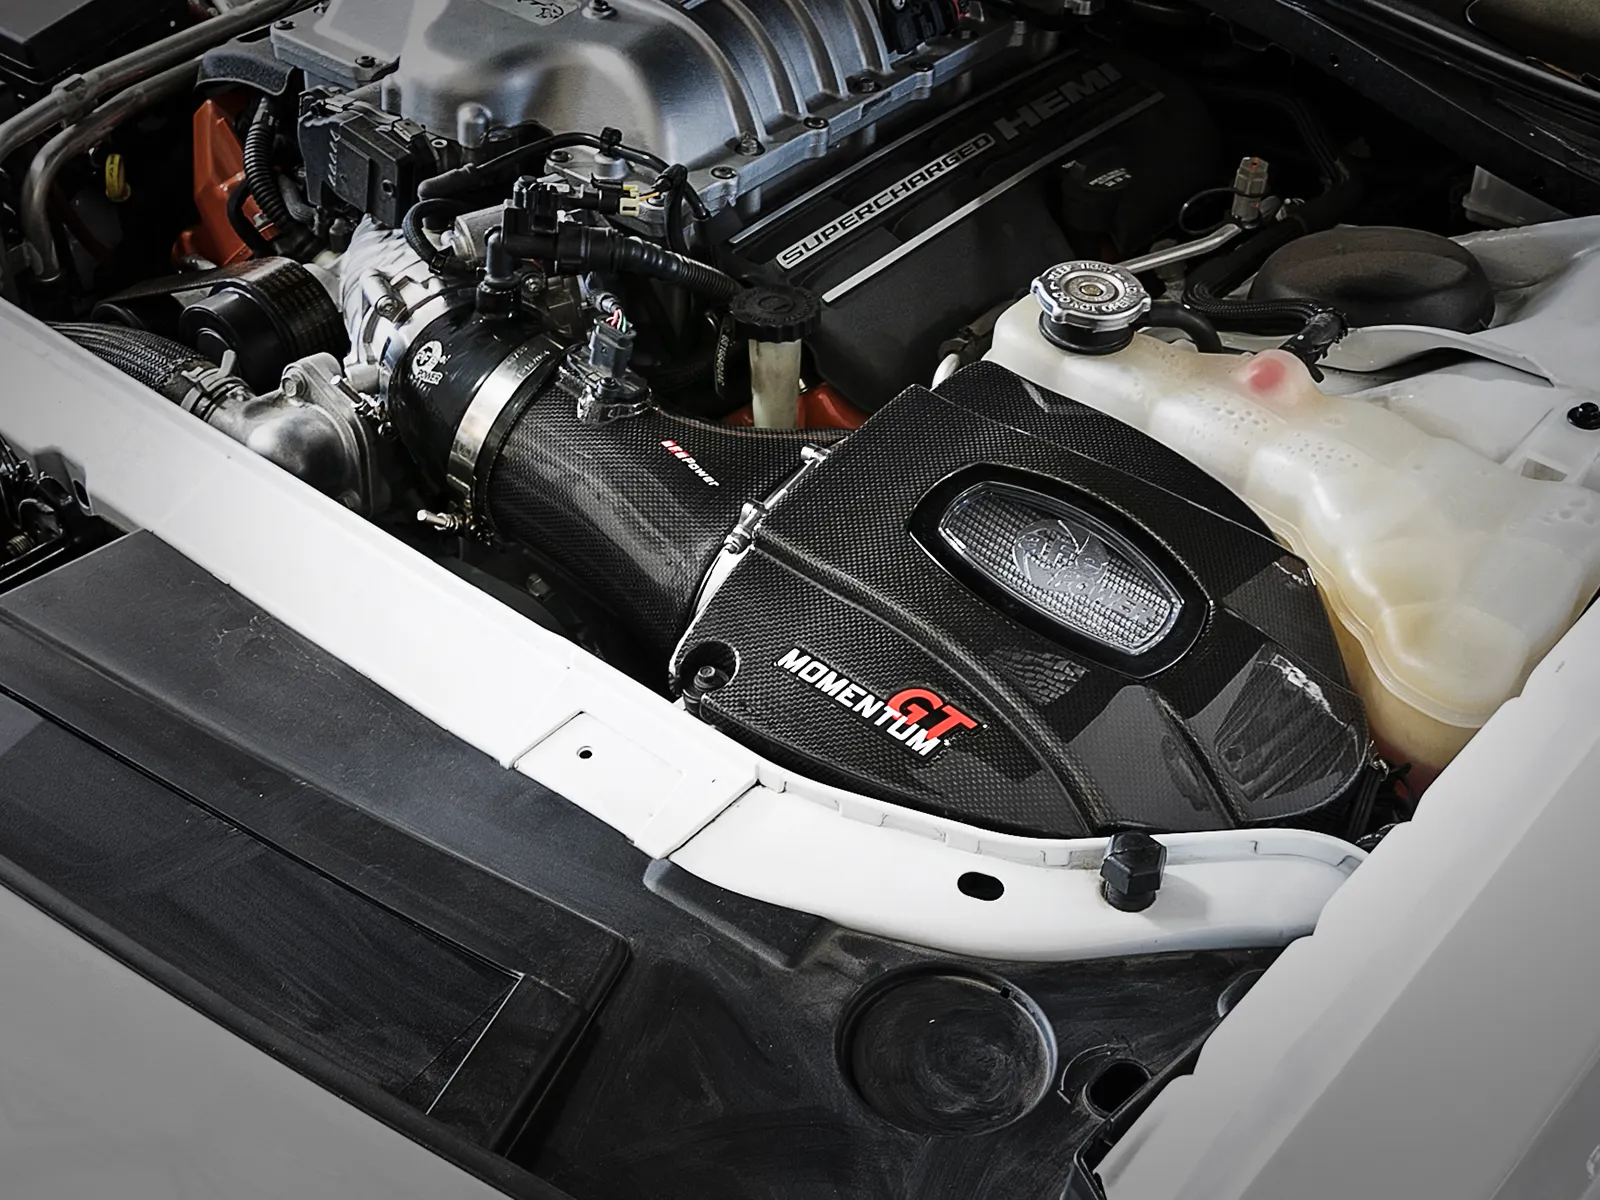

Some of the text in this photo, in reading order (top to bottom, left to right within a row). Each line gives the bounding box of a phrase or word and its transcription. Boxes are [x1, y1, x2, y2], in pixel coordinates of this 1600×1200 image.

[780, 62, 1122, 265] SUPERCHARGED HEMI
[417, 368, 442, 384] POWER
[1049, 566, 1160, 627] POWER
[776, 648, 941, 756] MOMENTUM
[887, 688, 978, 740] GT
